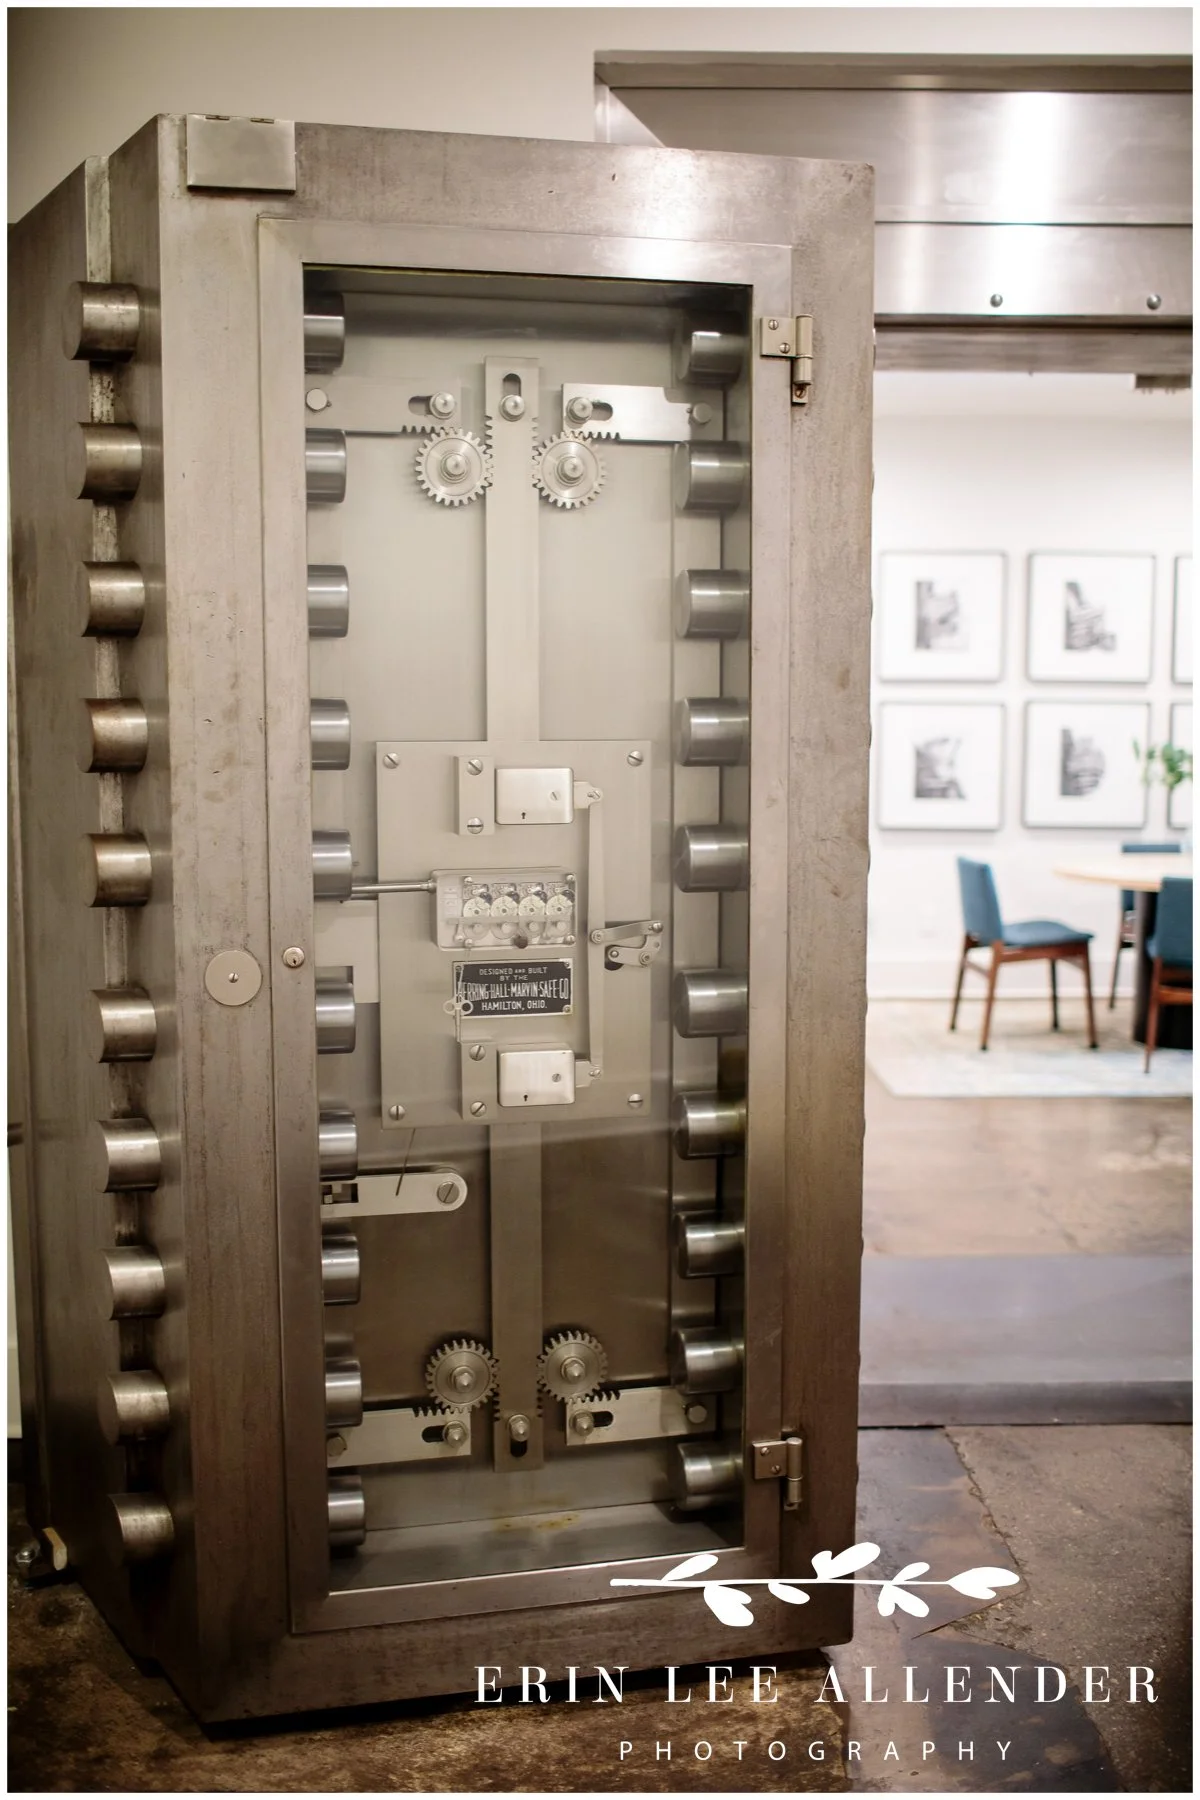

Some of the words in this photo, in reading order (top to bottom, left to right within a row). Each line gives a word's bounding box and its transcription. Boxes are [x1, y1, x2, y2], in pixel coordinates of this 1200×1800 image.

[479, 967, 514, 976] DESIGNED
[528, 966, 548, 974] BUILT
[481, 1001, 525, 1011] HAMILTON,
[527, 999, 548, 1009] OHIO.
